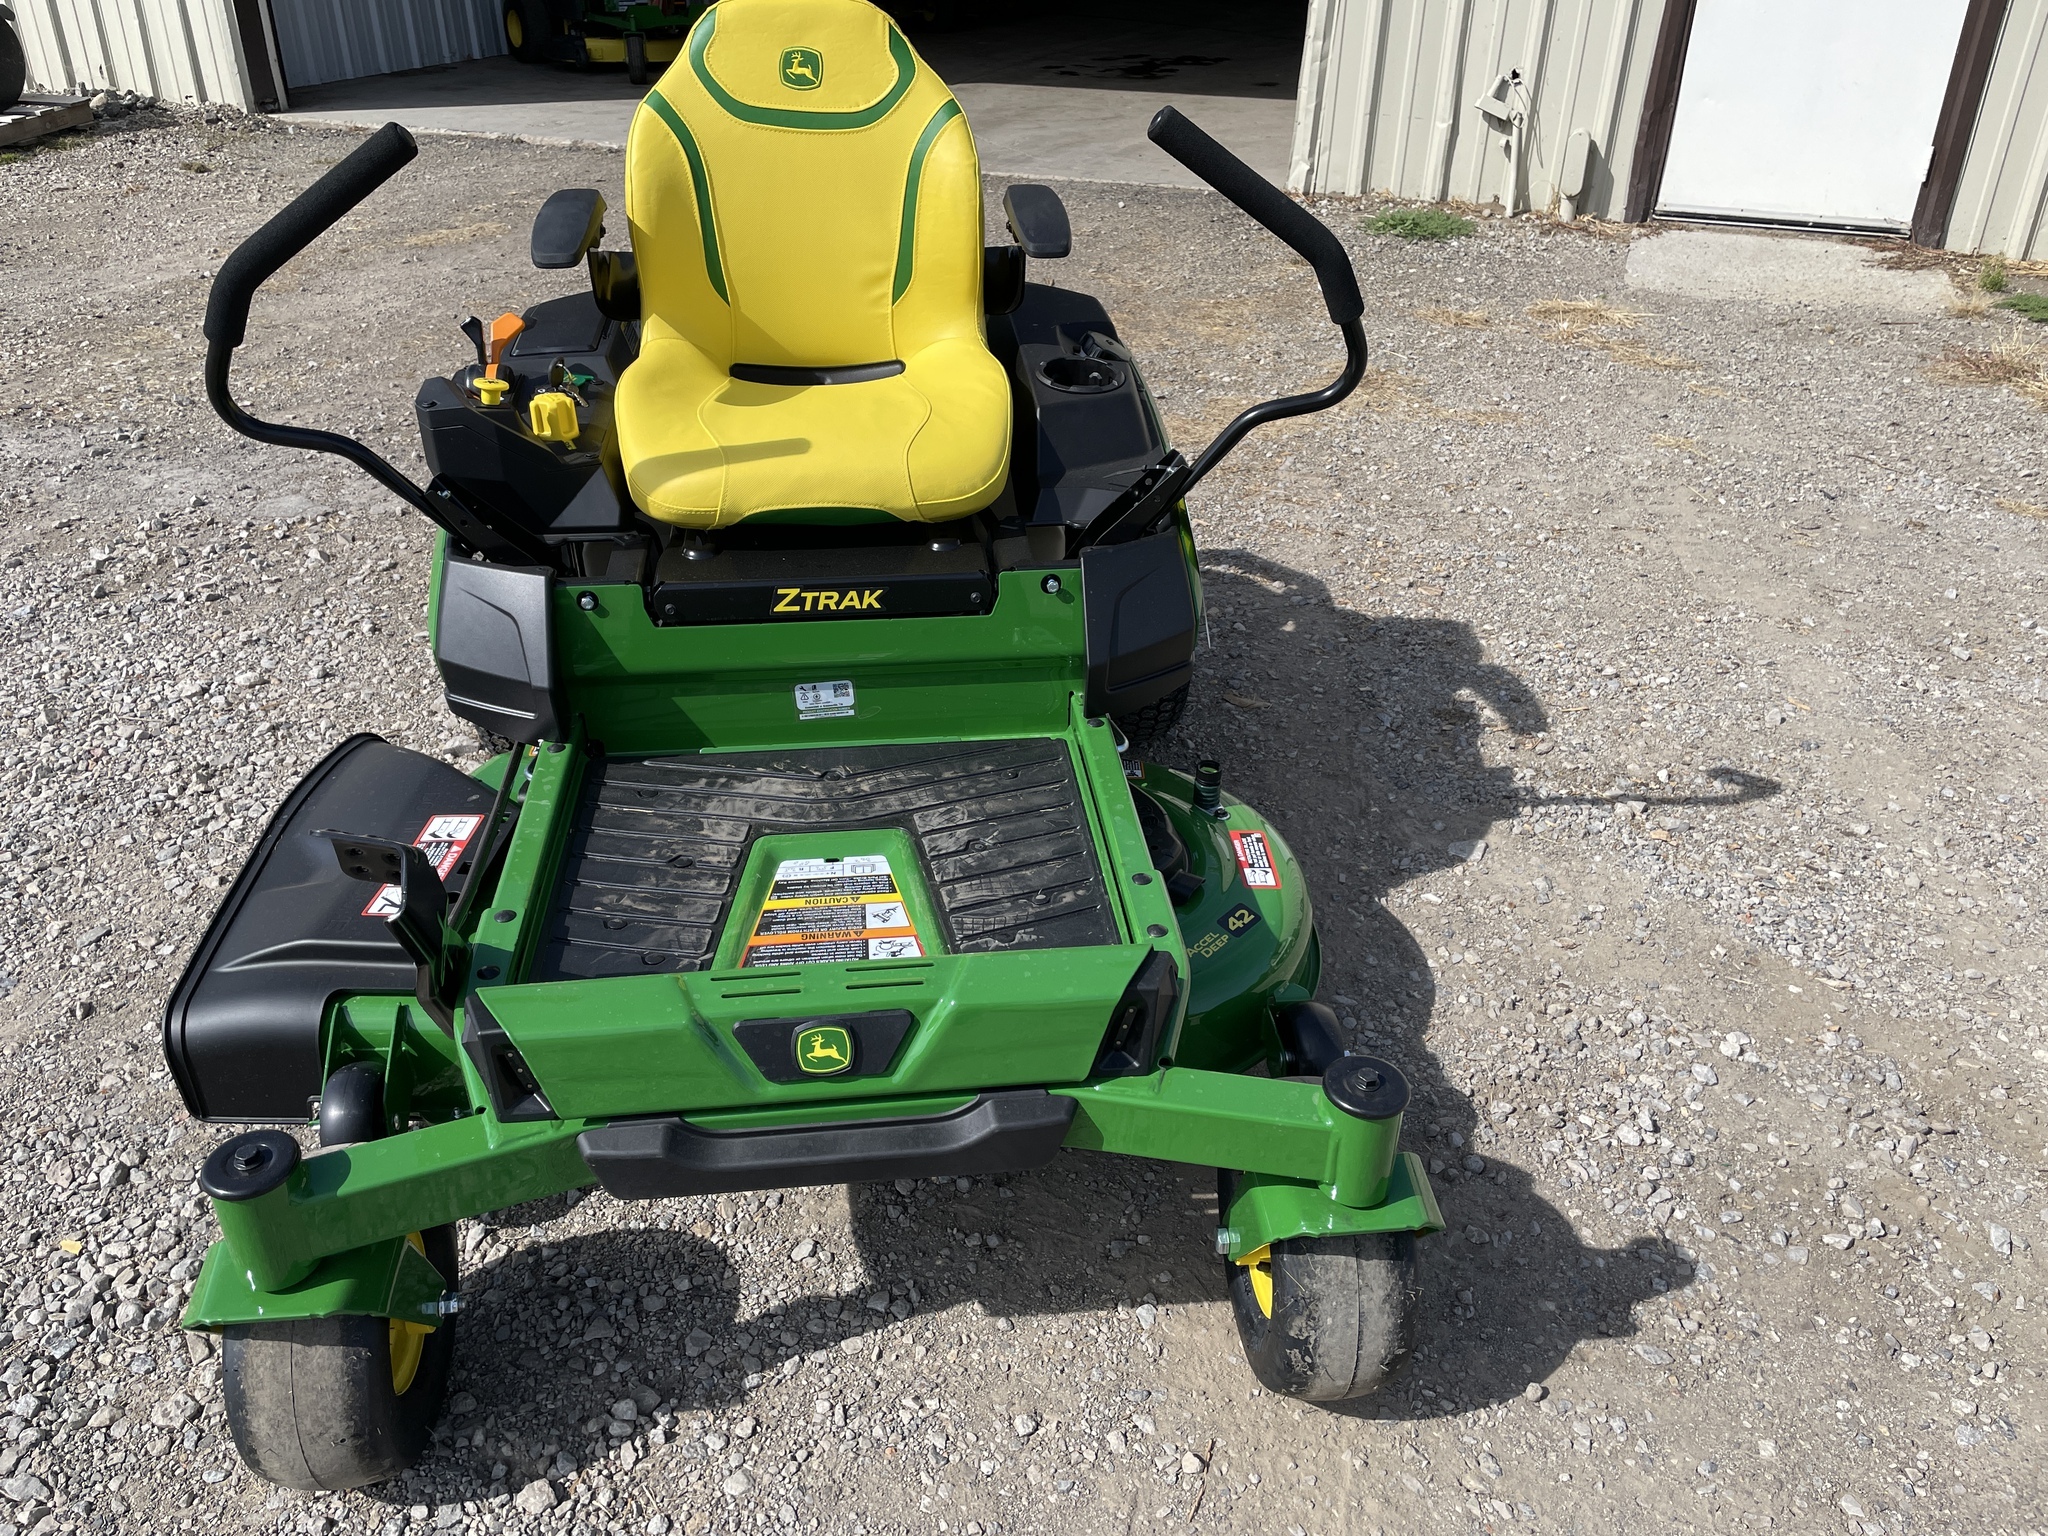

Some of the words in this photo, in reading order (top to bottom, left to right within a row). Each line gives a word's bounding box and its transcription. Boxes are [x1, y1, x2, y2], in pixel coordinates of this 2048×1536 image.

[773, 588, 884, 612] ZTRAK
[804, 896, 848, 905] CAUTION
[1228, 910, 1255, 931] 42
[801, 931, 852, 940] WARNING
[1186, 932, 1220, 958] ACCEL
[1200, 934, 1229, 958] DEEP
